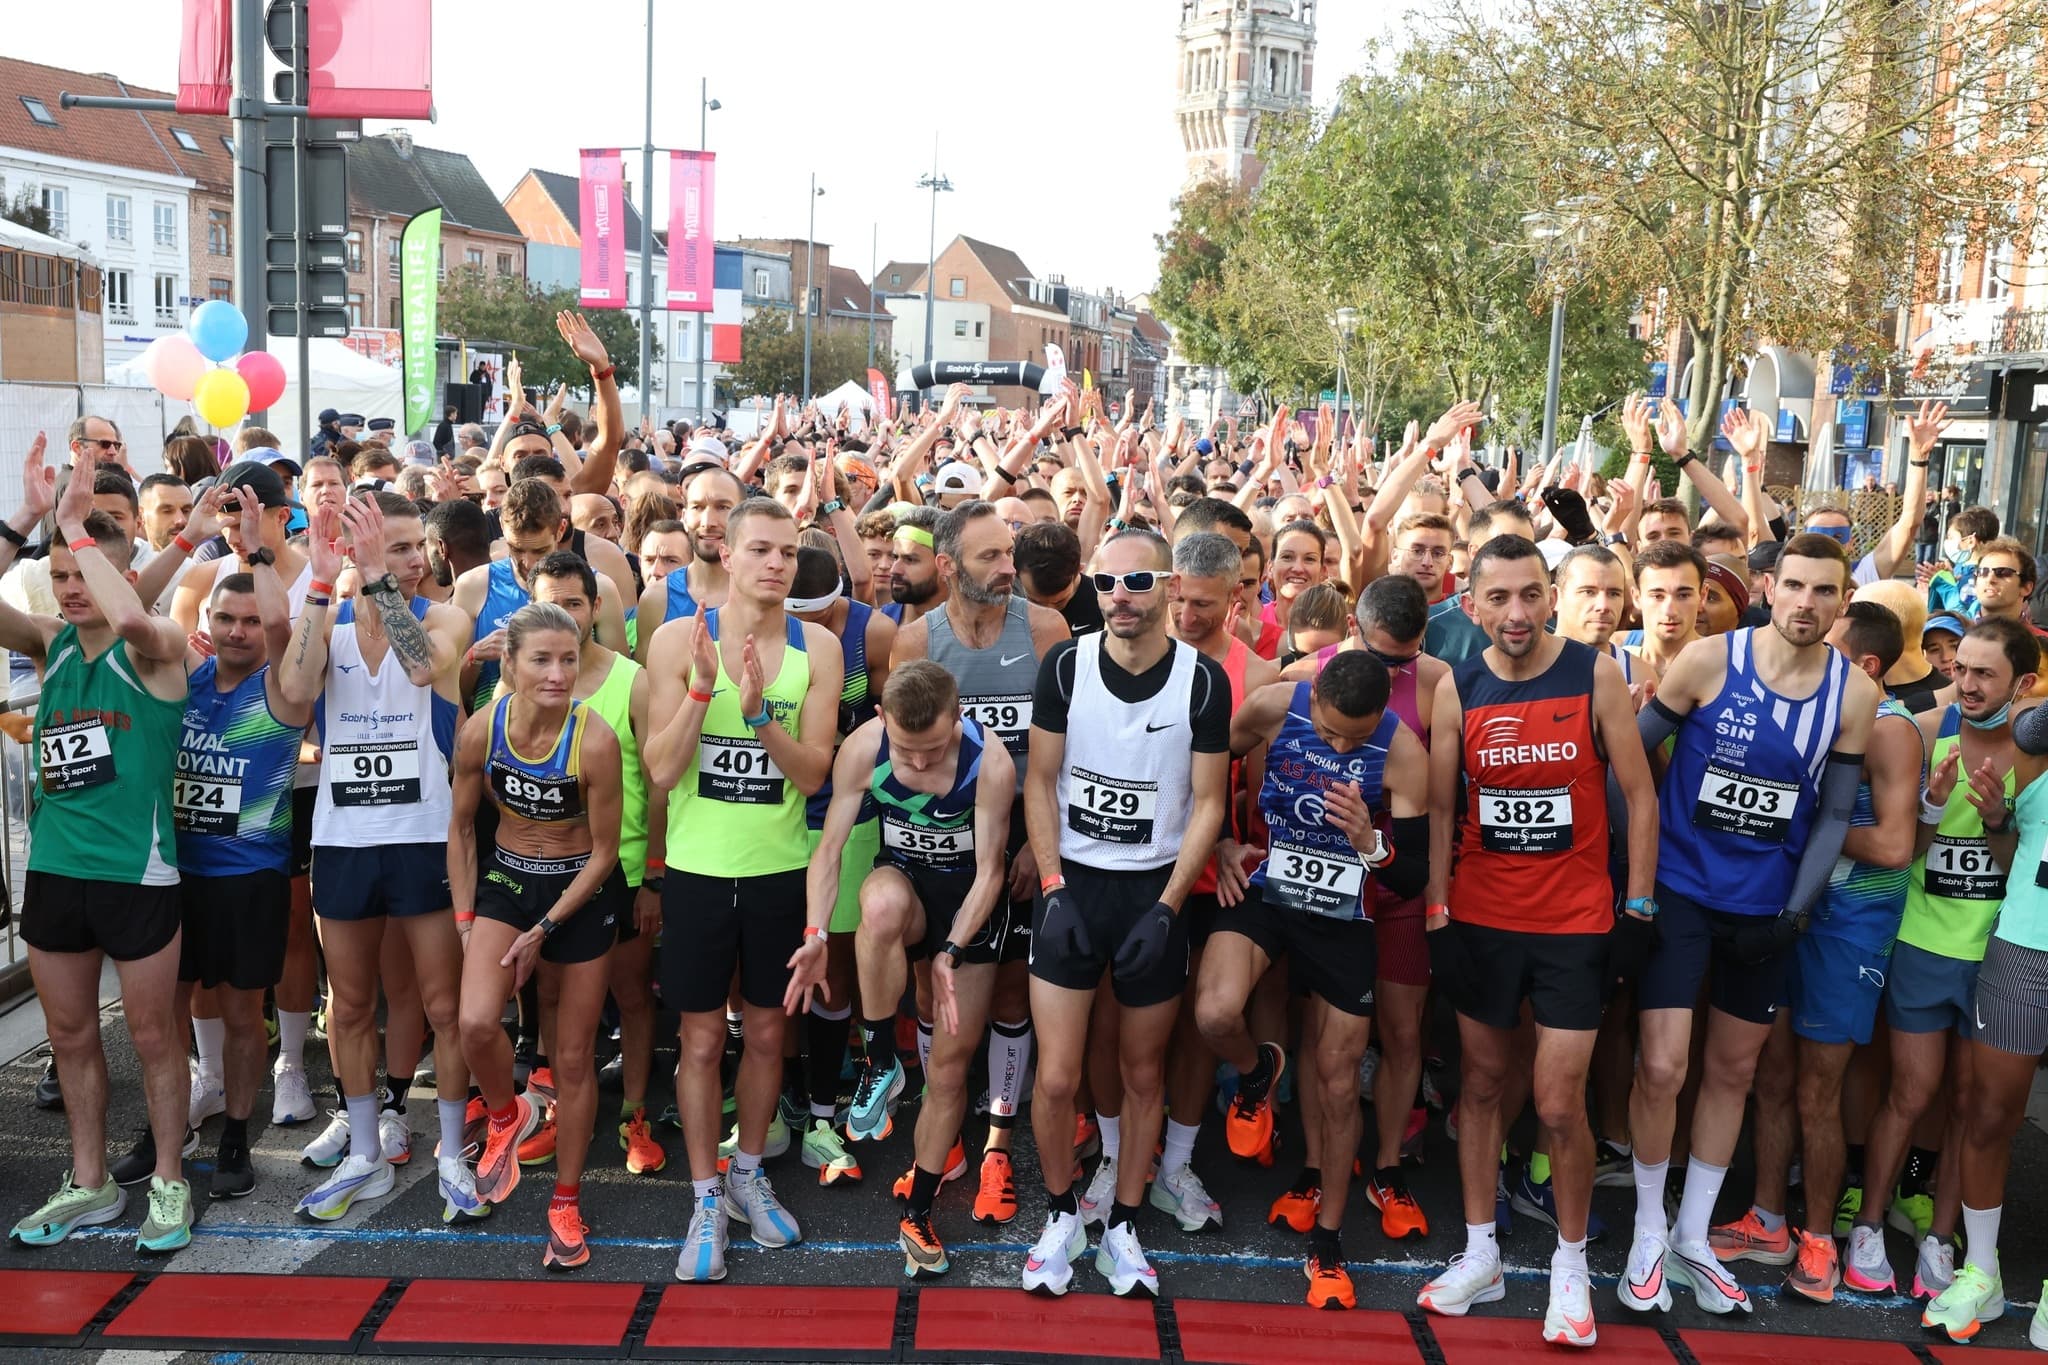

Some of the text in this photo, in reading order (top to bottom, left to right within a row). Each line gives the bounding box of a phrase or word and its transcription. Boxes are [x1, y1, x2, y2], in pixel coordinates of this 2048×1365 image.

[408, 238, 426, 380] HERBALIFE
[946, 364, 1008, 375] Sobhi sport
[978, 694, 1032, 703] TOURQUENNOISES
[339, 713, 414, 724] Sobhi sport
[964, 706, 1018, 728] 139
[1719, 708, 1758, 726] A.S
[44, 718, 102, 736] TOURQUENNOISES
[1715, 722, 1755, 741] SIN
[42, 734, 92, 763] 312
[182, 729, 230, 752] MAL
[360, 742, 416, 751] TOURQUENNOISES
[702, 736, 731, 745] BOUCLES
[176, 750, 250, 777] OYANT
[713, 750, 770, 775] 401
[1305, 750, 1340, 773] HICHAM
[1477, 742, 1577, 767] TERENEO
[45, 764, 96, 779] Sobhi sport
[354, 755, 392, 778] 90
[492, 760, 578, 784] BOUCLES TOURQUENNOISES
[1280, 758, 1305, 779] AS
[188, 772, 242, 784] TOURQUENNOISES
[712, 779, 735, 788] Sobhi
[1072, 768, 1158, 790] BOUCLES TOURQUENNOISES
[1707, 764, 1800, 791] BOUCLES TOURQUENNOISES
[176, 782, 224, 808] 124
[380, 784, 405, 793] sport
[505, 775, 564, 803] 894
[1480, 788, 1568, 796] BOUCLES TOURQUENNOISES
[1716, 783, 1780, 813] 403
[506, 798, 528, 809] Sobhi
[1083, 785, 1139, 816] 129
[199, 816, 223, 824] sport
[1080, 813, 1100, 826] Sobhi
[1493, 800, 1555, 824] 382
[1710, 809, 1774, 828] Sobhi sport
[886, 816, 970, 833] BOUCLES TOURQUENNOISES
[899, 831, 958, 851] 354
[1531, 832, 1557, 840] sport
[901, 851, 924, 859] Sobhi
[1273, 840, 1359, 864] BOUCLES TOURQUENNOISES
[1940, 848, 1993, 872] 167
[505, 856, 588, 871] new balance ne
[1284, 855, 1346, 887] 397
[1938, 877, 1998, 888] Sobhi sport
[1278, 885, 1341, 904] Sobhi sport
